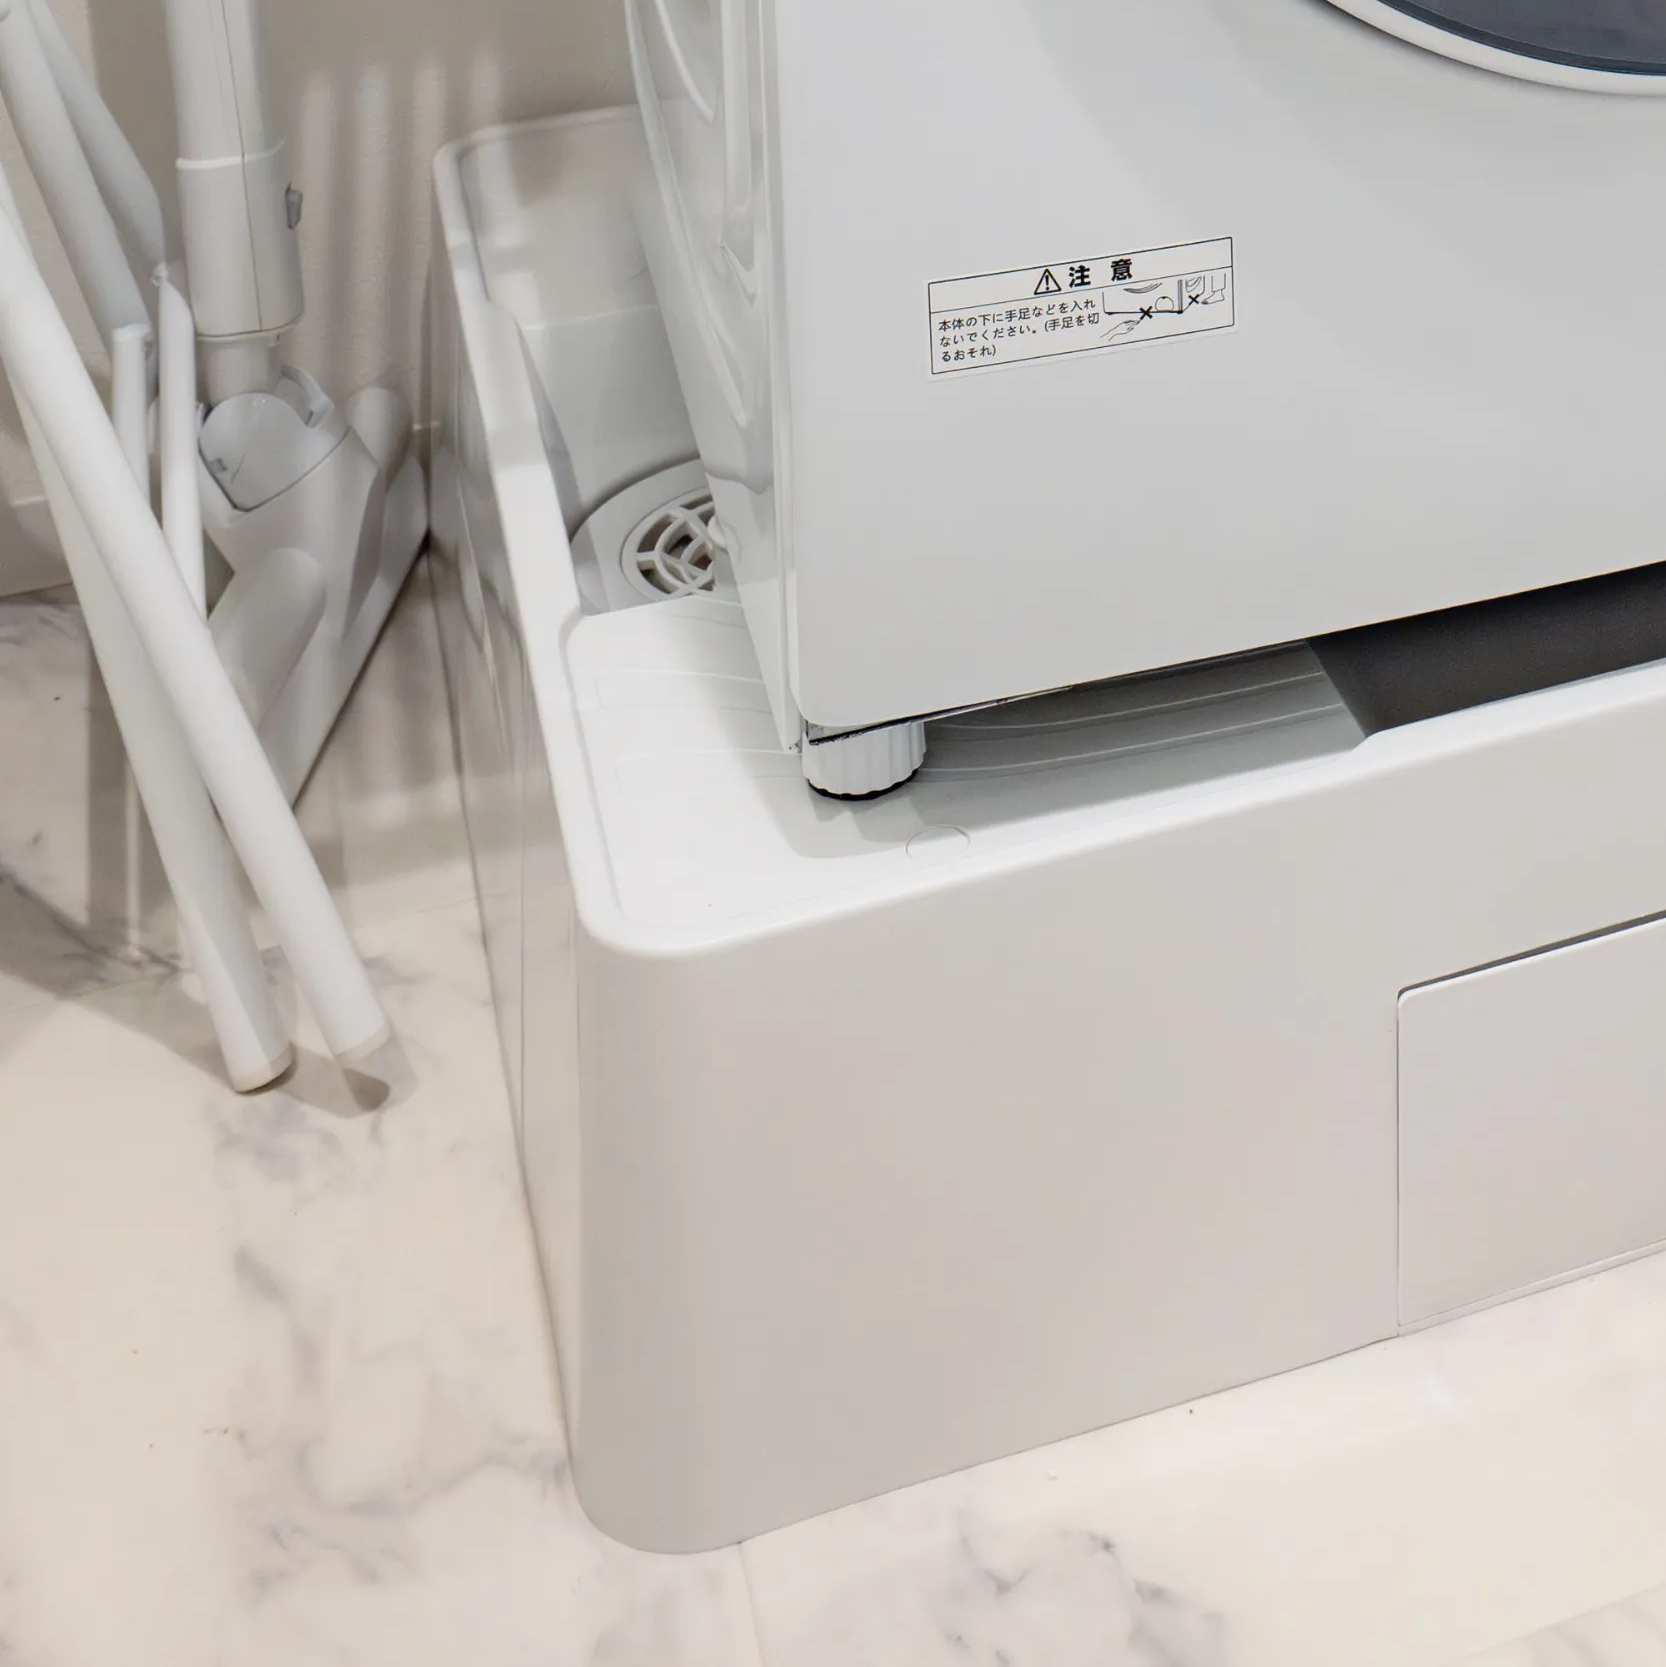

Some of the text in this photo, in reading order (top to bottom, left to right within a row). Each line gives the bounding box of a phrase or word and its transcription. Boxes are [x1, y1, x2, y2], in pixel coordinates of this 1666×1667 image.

[1068, 258, 1133, 288] 注意
[938, 298, 1096, 333] 本体の下に手足などを入れ
